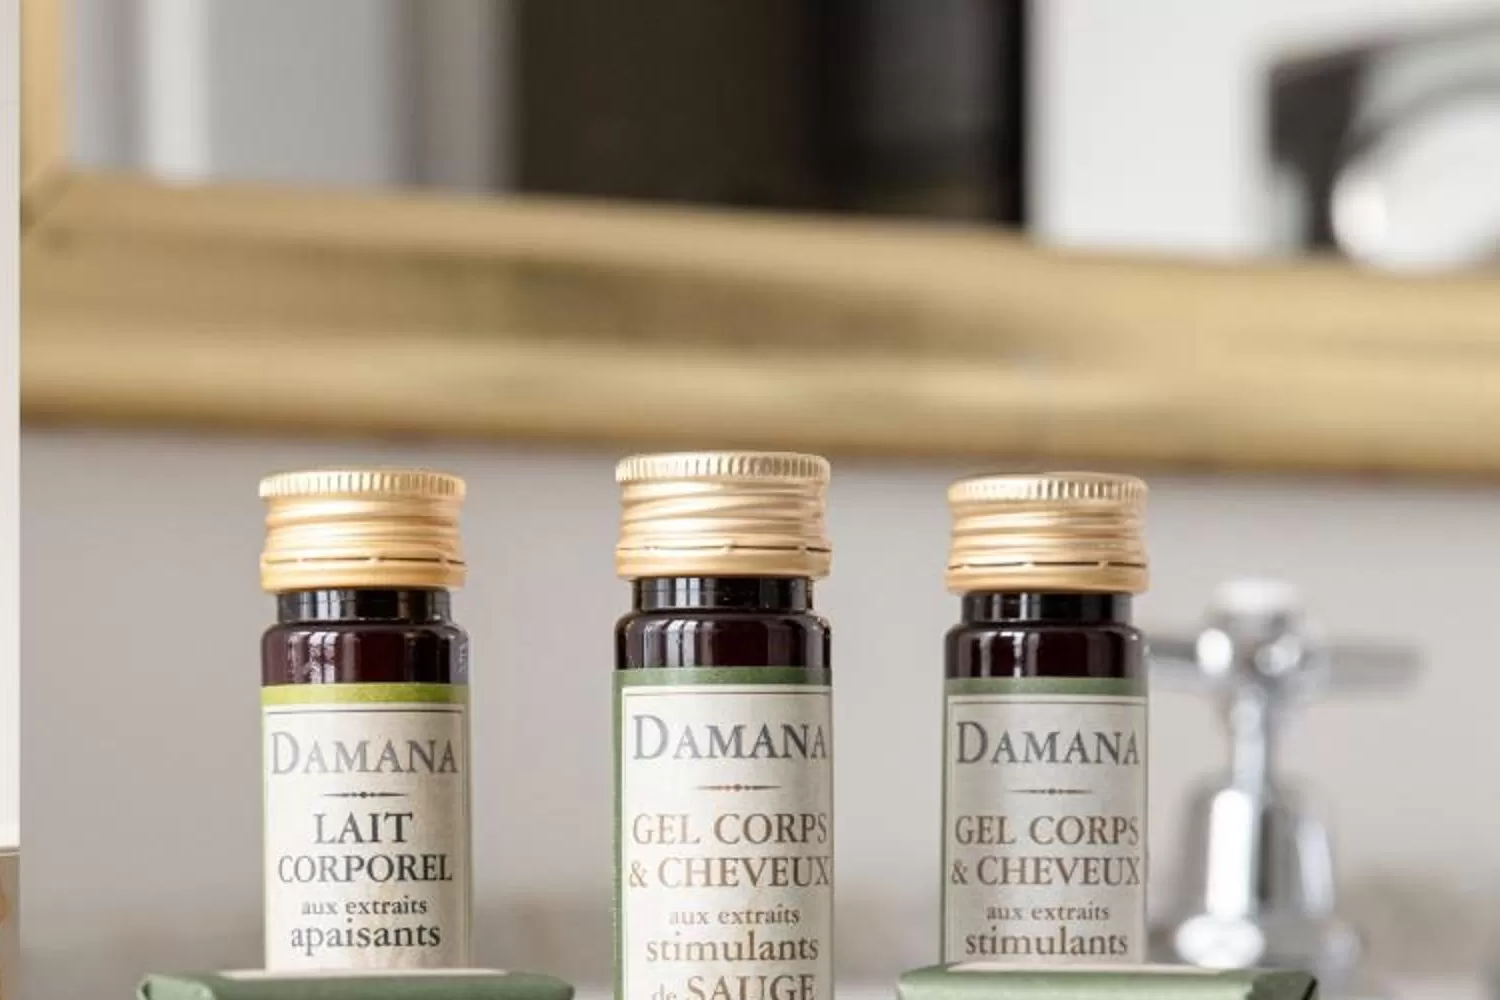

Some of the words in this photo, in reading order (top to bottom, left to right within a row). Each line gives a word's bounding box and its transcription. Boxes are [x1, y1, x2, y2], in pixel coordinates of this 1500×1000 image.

[632, 714, 827, 760] DAMANA
[956, 721, 1140, 765] DAMANA
[270, 731, 459, 775] DAMANA
[313, 811, 413, 844] LAIT
[632, 813, 700, 845] GEL
[713, 813, 827, 845] CORPS
[955, 815, 1016, 846] GEL
[1029, 815, 1139, 846] CORPS
[278, 854, 453, 883] CORPOREL
[629, 859, 647, 888] &
[658, 856, 831, 888] CHEVEUX
[951, 860, 968, 886] &
[977, 855, 1140, 886] CHEVEUX
[301, 901, 337, 915] aux
[345, 895, 428, 915] extraits
[669, 911, 708, 925] aux
[717, 904, 801, 925] extraits
[986, 906, 1023, 921] aux
[1031, 900, 1110, 921] extraits
[290, 918, 441, 956] apaisants
[646, 931, 819, 962] stimulants
[965, 926, 1128, 956] stimulants
